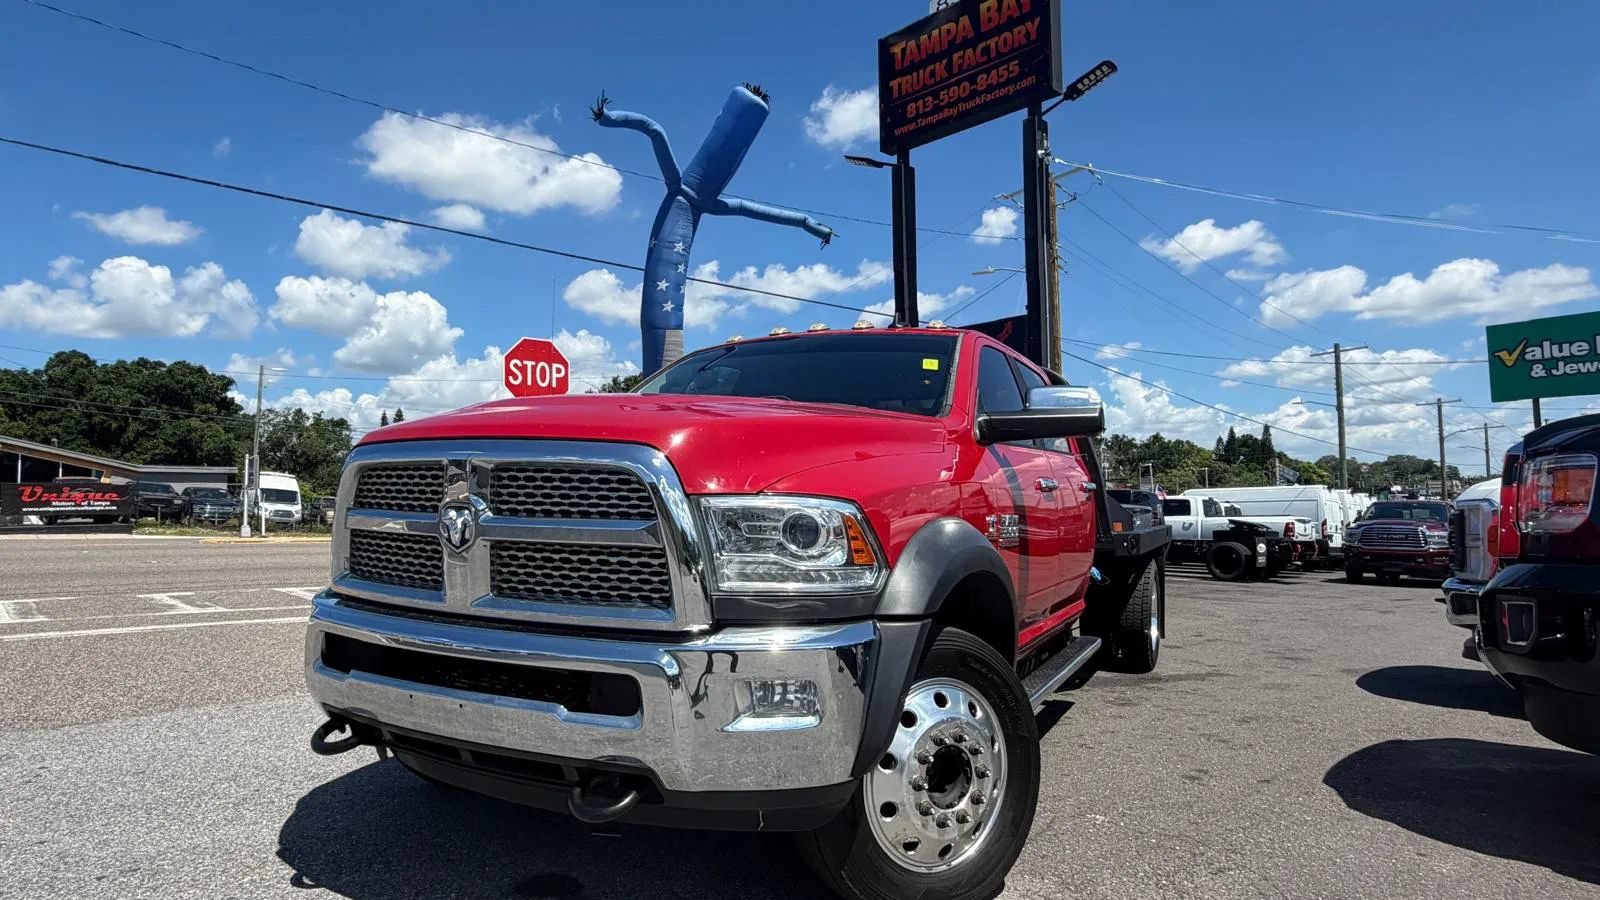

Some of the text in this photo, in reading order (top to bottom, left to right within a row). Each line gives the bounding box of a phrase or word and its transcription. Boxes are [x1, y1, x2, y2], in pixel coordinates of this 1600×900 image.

[889, 14, 974, 70] TAMPA
[889, 16, 1041, 98] TRUCK FACTORY
[894, 75, 1036, 136] www.TampaBayTruckFactory.com
[906, 60, 1020, 118] 813-590-8455
[508, 358, 566, 388] STOP
[1530, 361, 1600, 378] & Jew
[19, 486, 120, 504] Unique
